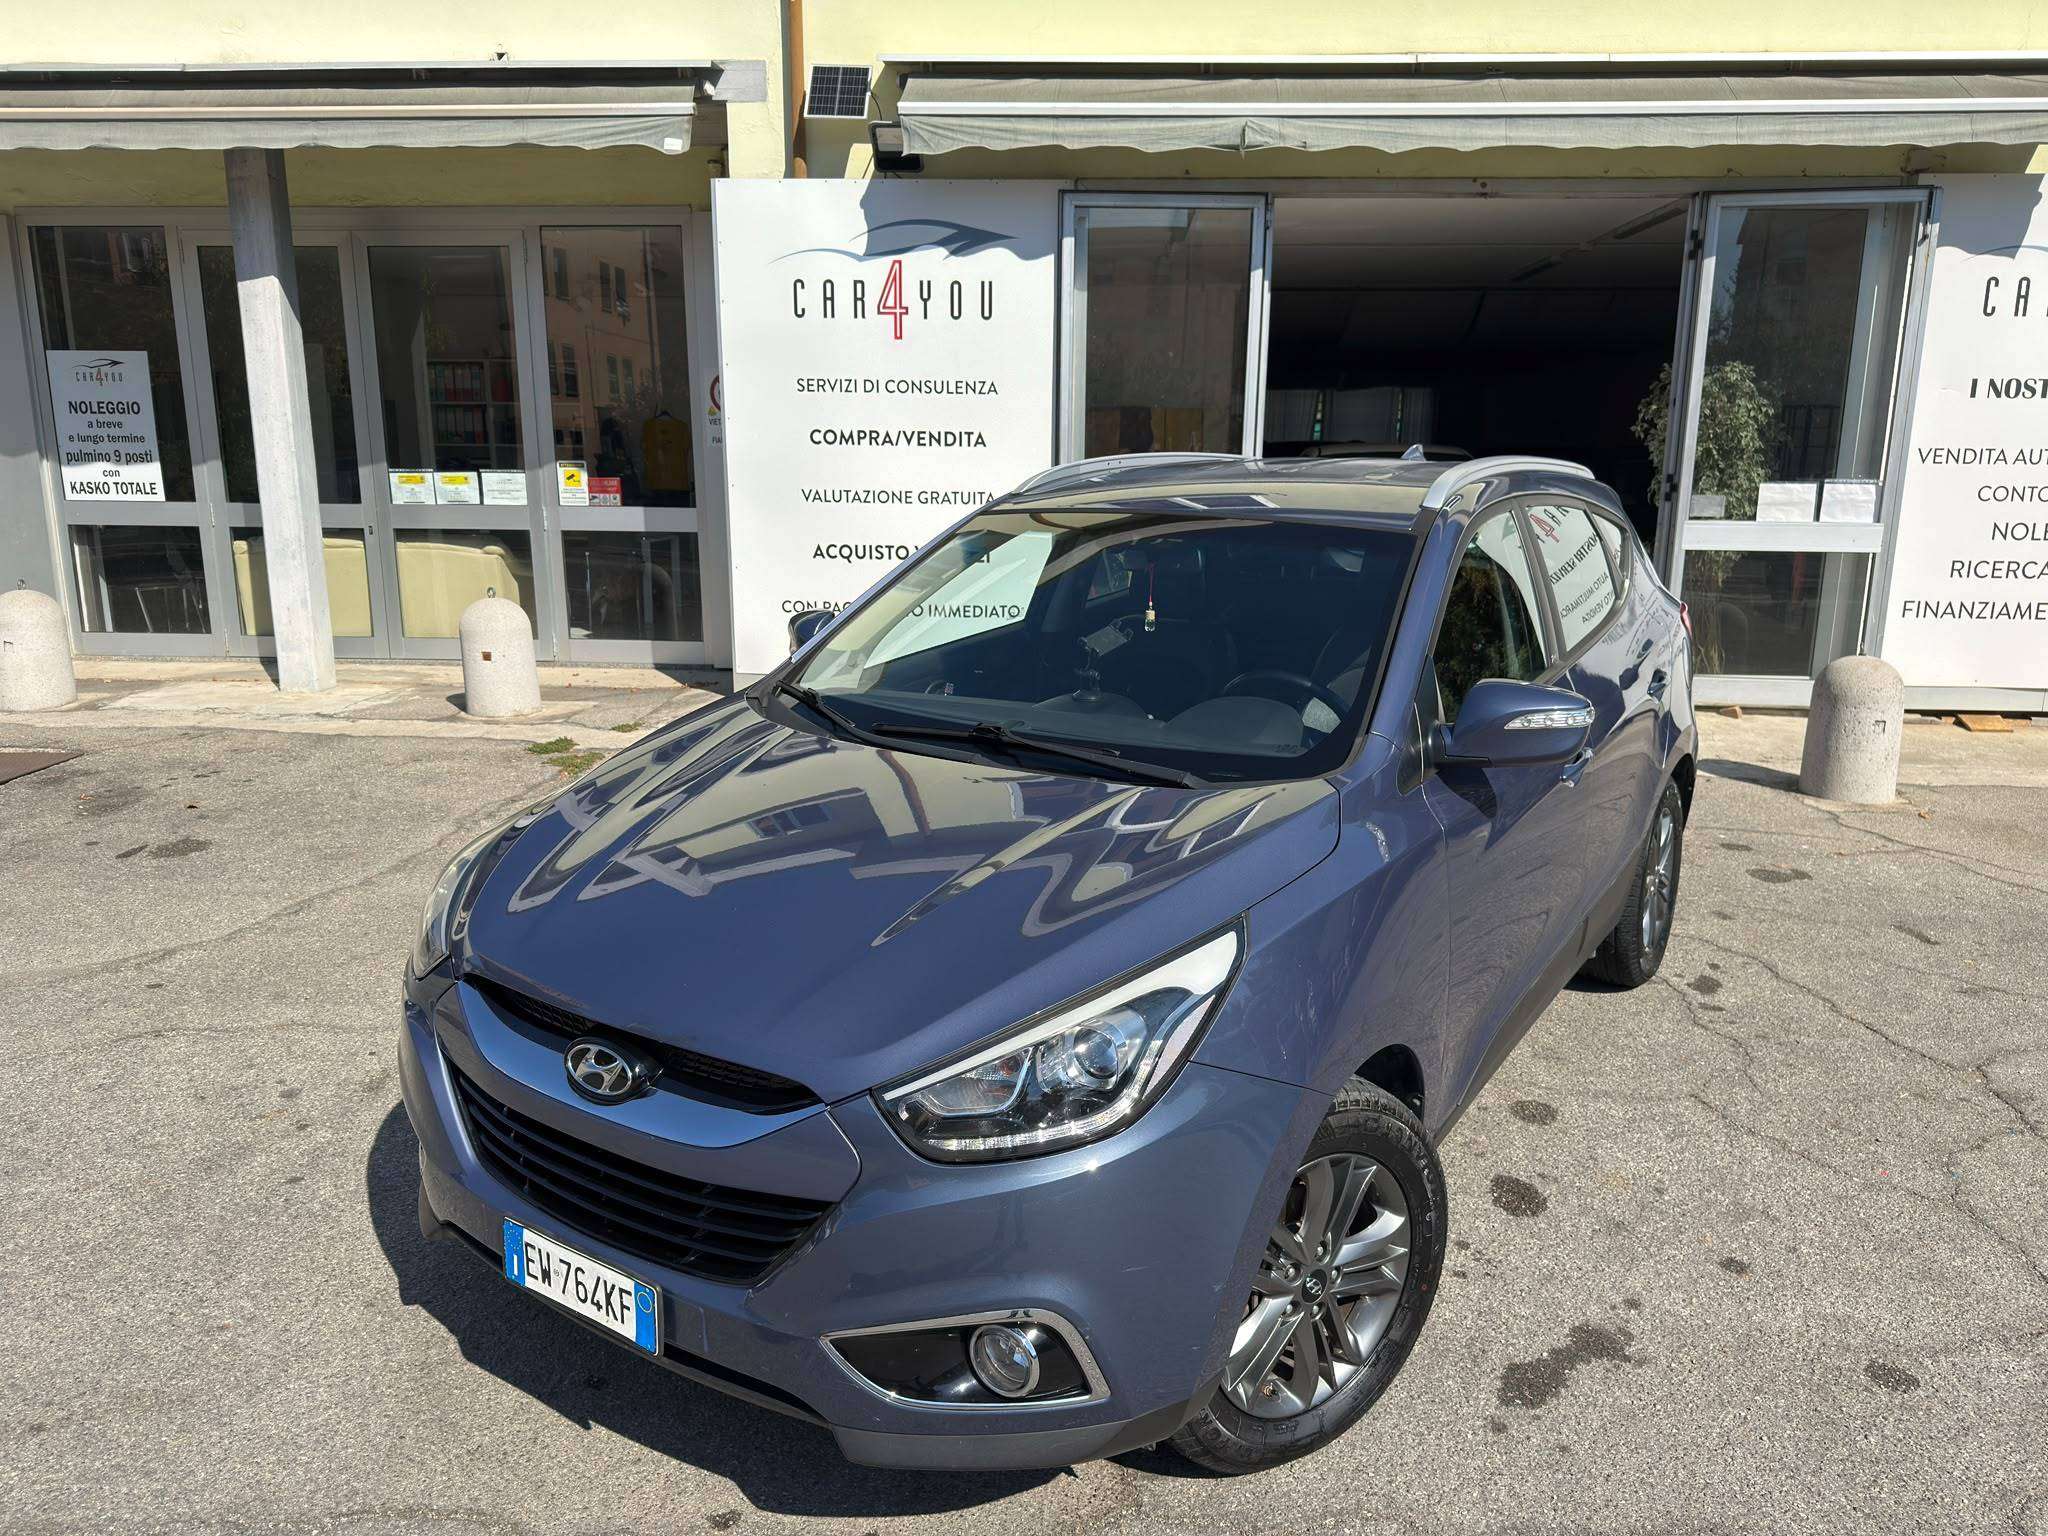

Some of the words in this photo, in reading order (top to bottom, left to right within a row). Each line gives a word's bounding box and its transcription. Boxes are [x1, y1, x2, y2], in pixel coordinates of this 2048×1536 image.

[1983, 276, 2048, 317] CA
[796, 378, 857, 393] SERVIZI
[863, 379, 880, 394] DI
[885, 379, 999, 395] CONSULENZA
[1969, 378, 1978, 399] I
[68, 400, 141, 415] NOLEGGIO
[88, 420, 94, 429] a
[96, 419, 123, 429] breve
[68, 434, 75, 443] e
[77, 433, 104, 445] lungo
[107, 433, 146, 443] termine
[809, 428, 987, 448] COMPRA/VENDITA
[66, 450, 111, 465] pulmino
[114, 450, 121, 463] 9
[125, 450, 153, 465] posti
[1918, 448, 2008, 465] VENDITA
[102, 468, 121, 478] con
[70, 481, 110, 495] KASKO
[113, 481, 158, 495] TOTALE
[801, 488, 913, 504] VALUTAZIONE
[918, 490, 995, 505] GRATUITA
[812, 543, 909, 563] ACQUISTO
[1950, 560, 2048, 579] RICERCA
[782, 600, 817, 613] CON
[928, 604, 1021, 618] IMMEDIATO
[1902, 600, 2048, 620] FINANZIAME
